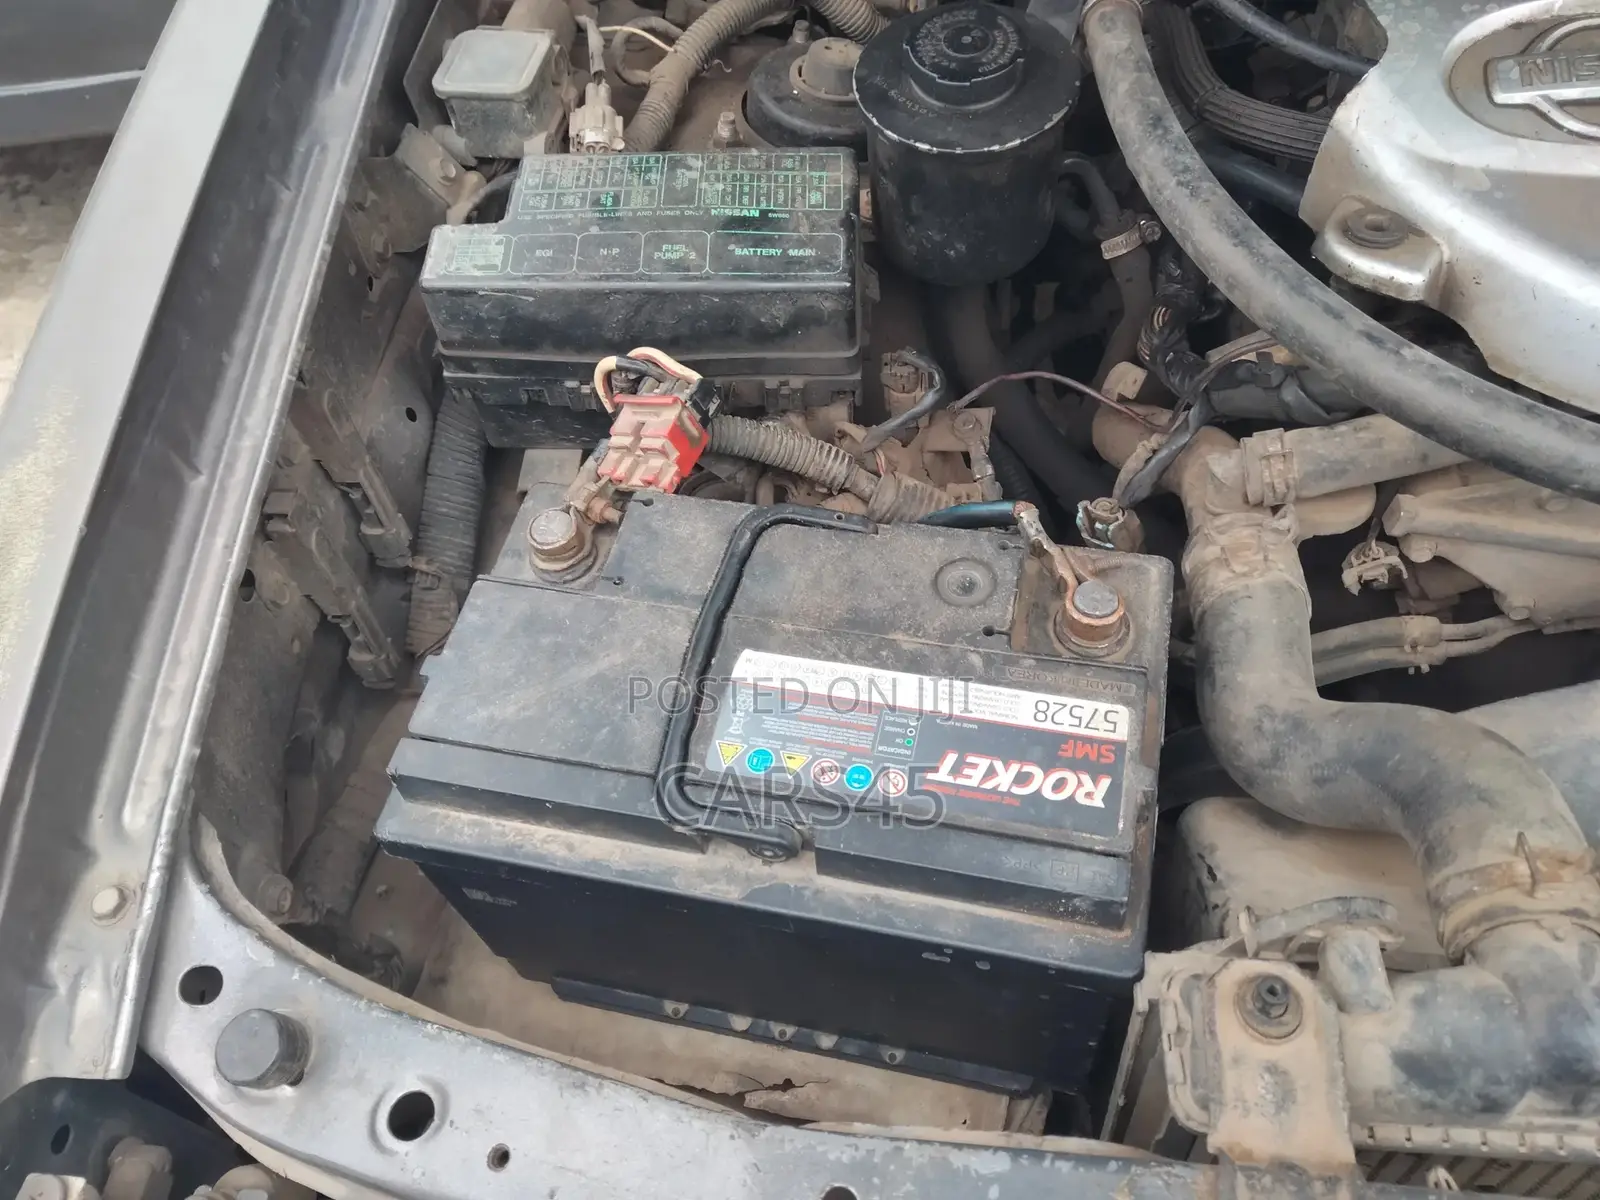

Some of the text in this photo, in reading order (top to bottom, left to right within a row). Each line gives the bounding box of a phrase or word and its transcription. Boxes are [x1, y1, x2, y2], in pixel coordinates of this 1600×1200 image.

[711, 208, 760, 218] NISSAN
[662, 243, 689, 252] FUEL
[734, 247, 783, 257] BATTERY
[788, 248, 816, 256] MAIN
[654, 251, 697, 260] PUMP 2
[1032, 698, 1120, 734] 57528
[1057, 739, 1116, 764] SMF
[925, 750, 1112, 808] ROCKET
